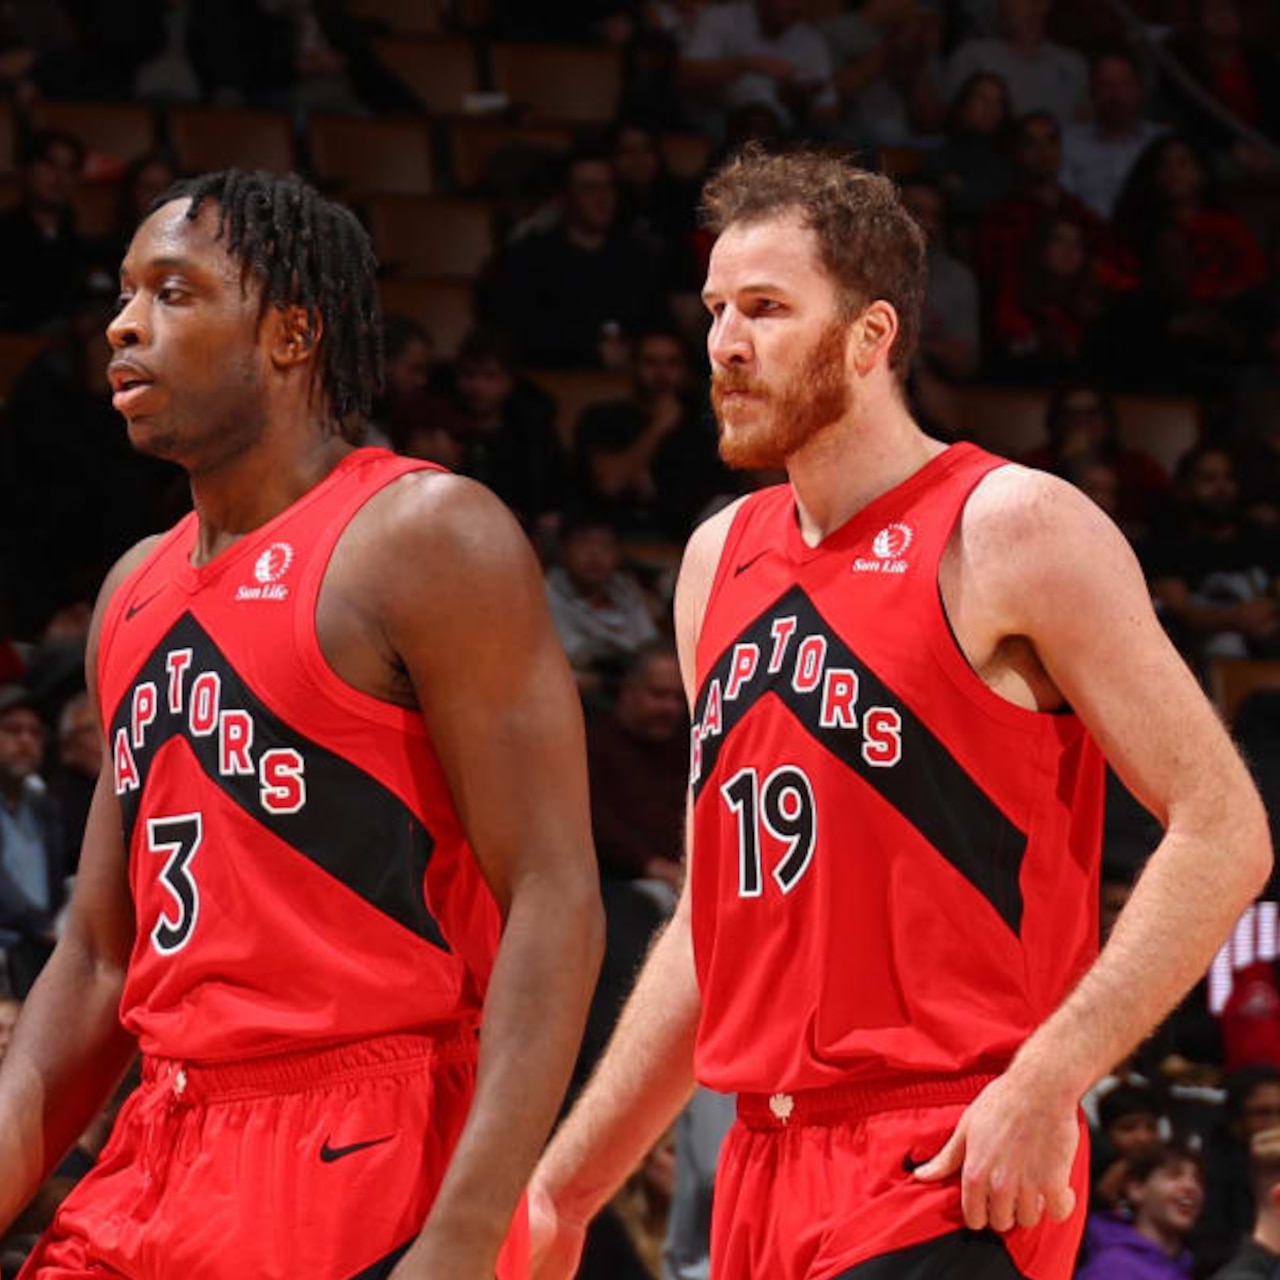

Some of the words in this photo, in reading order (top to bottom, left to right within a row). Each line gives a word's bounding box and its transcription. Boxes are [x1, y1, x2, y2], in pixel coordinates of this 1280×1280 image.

[114, 648, 306, 815] APTORS
[147, 812, 202, 955] 3
[720, 764, 816, 897] 19
